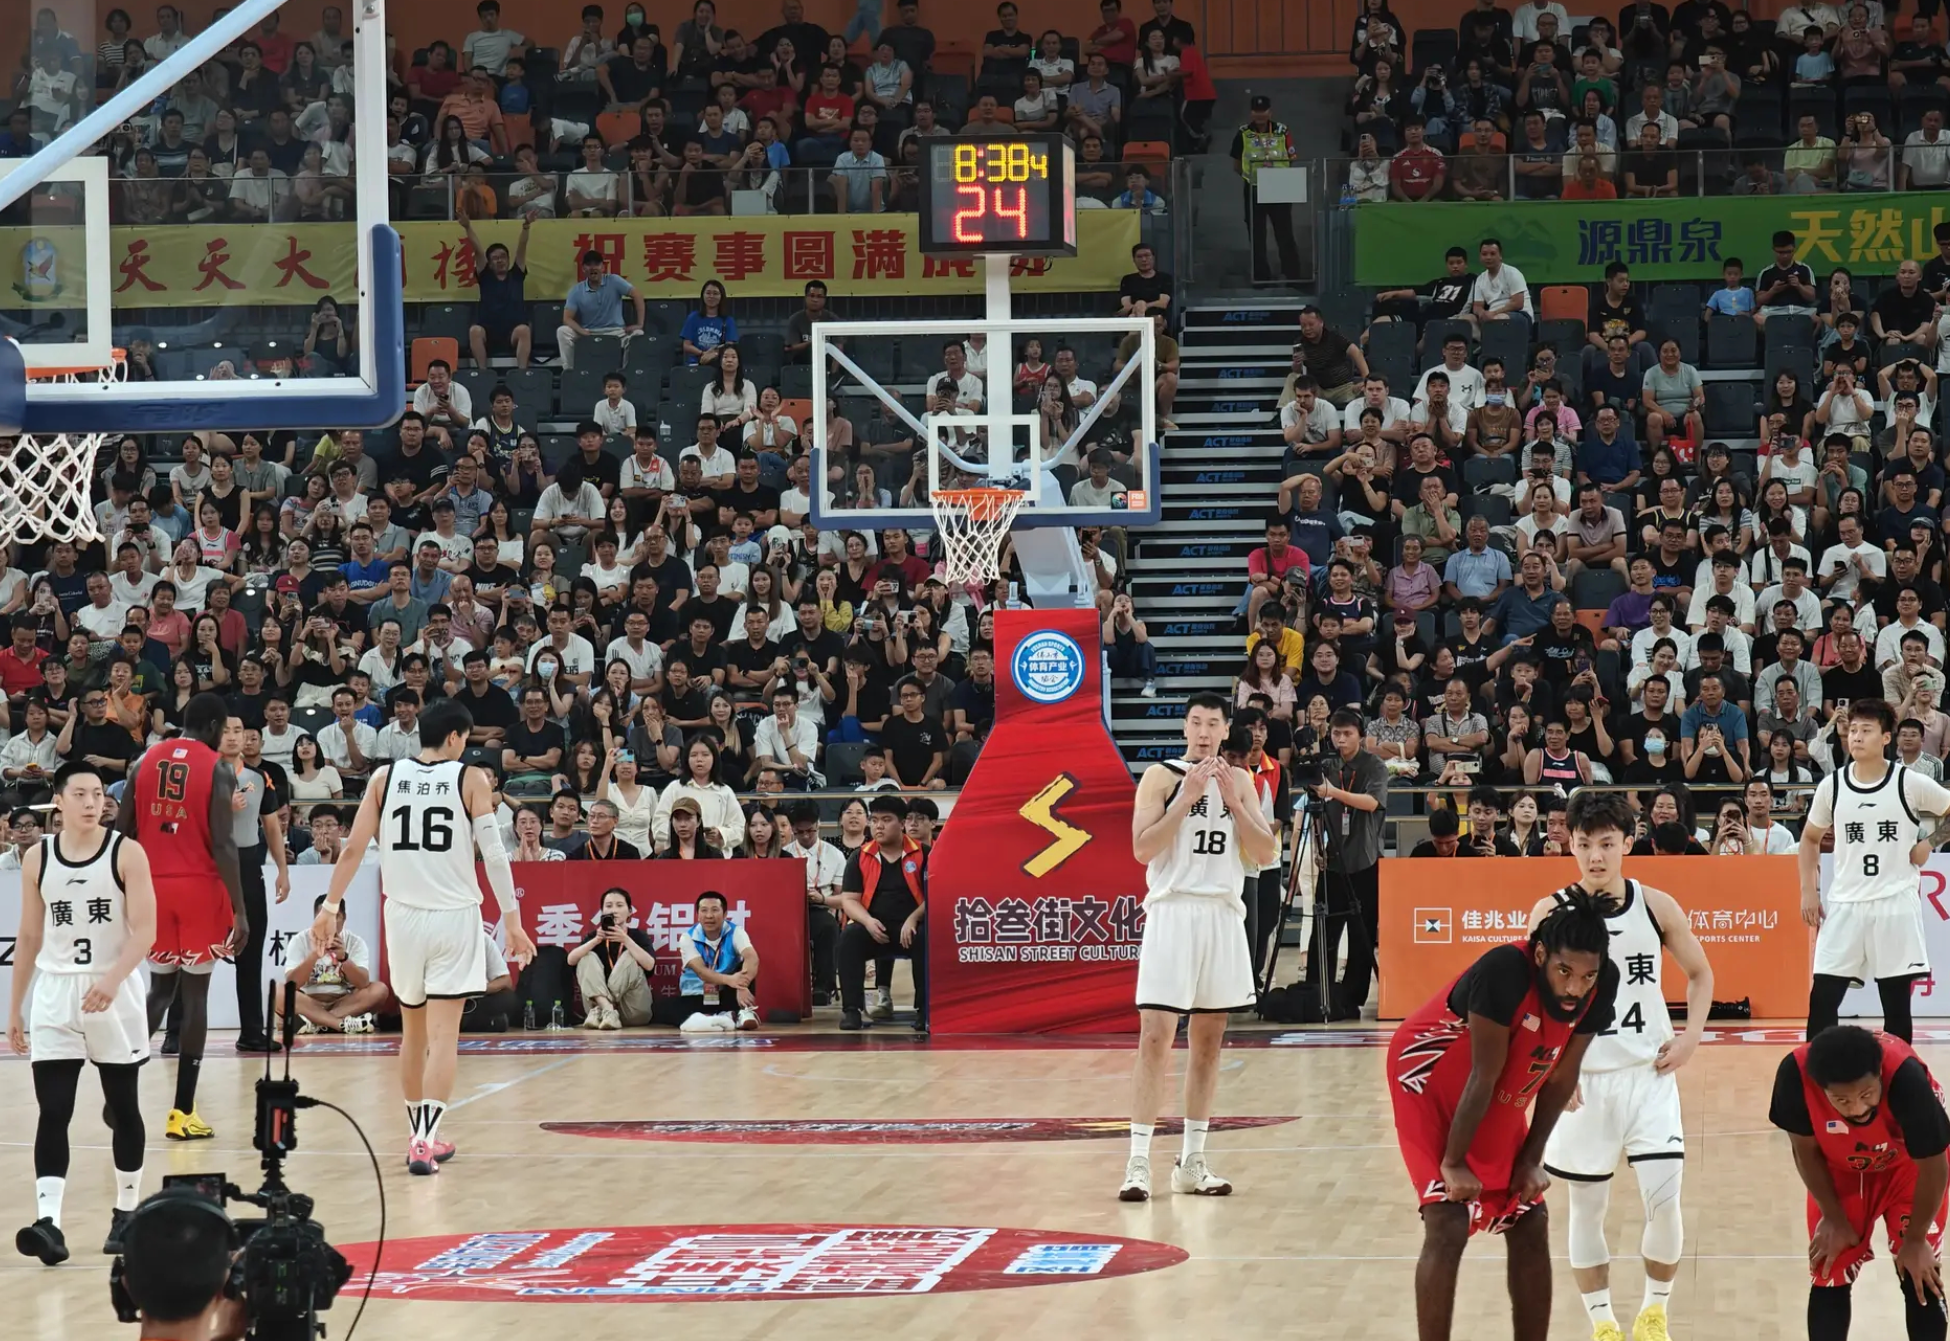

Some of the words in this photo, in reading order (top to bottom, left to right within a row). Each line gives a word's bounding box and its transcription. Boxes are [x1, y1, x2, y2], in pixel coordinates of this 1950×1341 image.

[954, 185, 1027, 243] 24
[1577, 217, 1723, 266] 源鼎泉
[1438, 285, 1463, 301] 31
[1223, 312, 1248, 321] ACT
[1219, 369, 1243, 378] ACT
[1211, 402, 1235, 412] ACT
[1203, 437, 1229, 447] ACT
[1196, 472, 1222, 482] ACT
[1189, 509, 1216, 519] ACT
[1180, 546, 1206, 556] ACT
[1172, 584, 1199, 595] ACT
[1164, 624, 1190, 634] ACT
[1029, 661, 1067, 671] 体育产业
[1155, 664, 1183, 674] ACT
[1146, 705, 1173, 716] ACT
[1137, 747, 1165, 758] ACT
[156, 759, 190, 802] 19
[397, 780, 450, 795] 焦泊乔
[151, 803, 187, 819] USA
[392, 805, 454, 852] 16
[1845, 819, 1899, 844] 廣東
[1193, 829, 1227, 855] 18
[1863, 854, 1879, 876] 8
[50, 896, 112, 927] 廣東
[954, 895, 1146, 943] 拾叁街文化
[1462, 935, 1486, 943] KAISA
[1728, 935, 1760, 943] CENTER
[73, 938, 92, 965] 3
[959, 946, 1017, 962] SHISAN
[1020, 945, 1077, 962] STREET
[1527, 1061, 1553, 1095] 7
